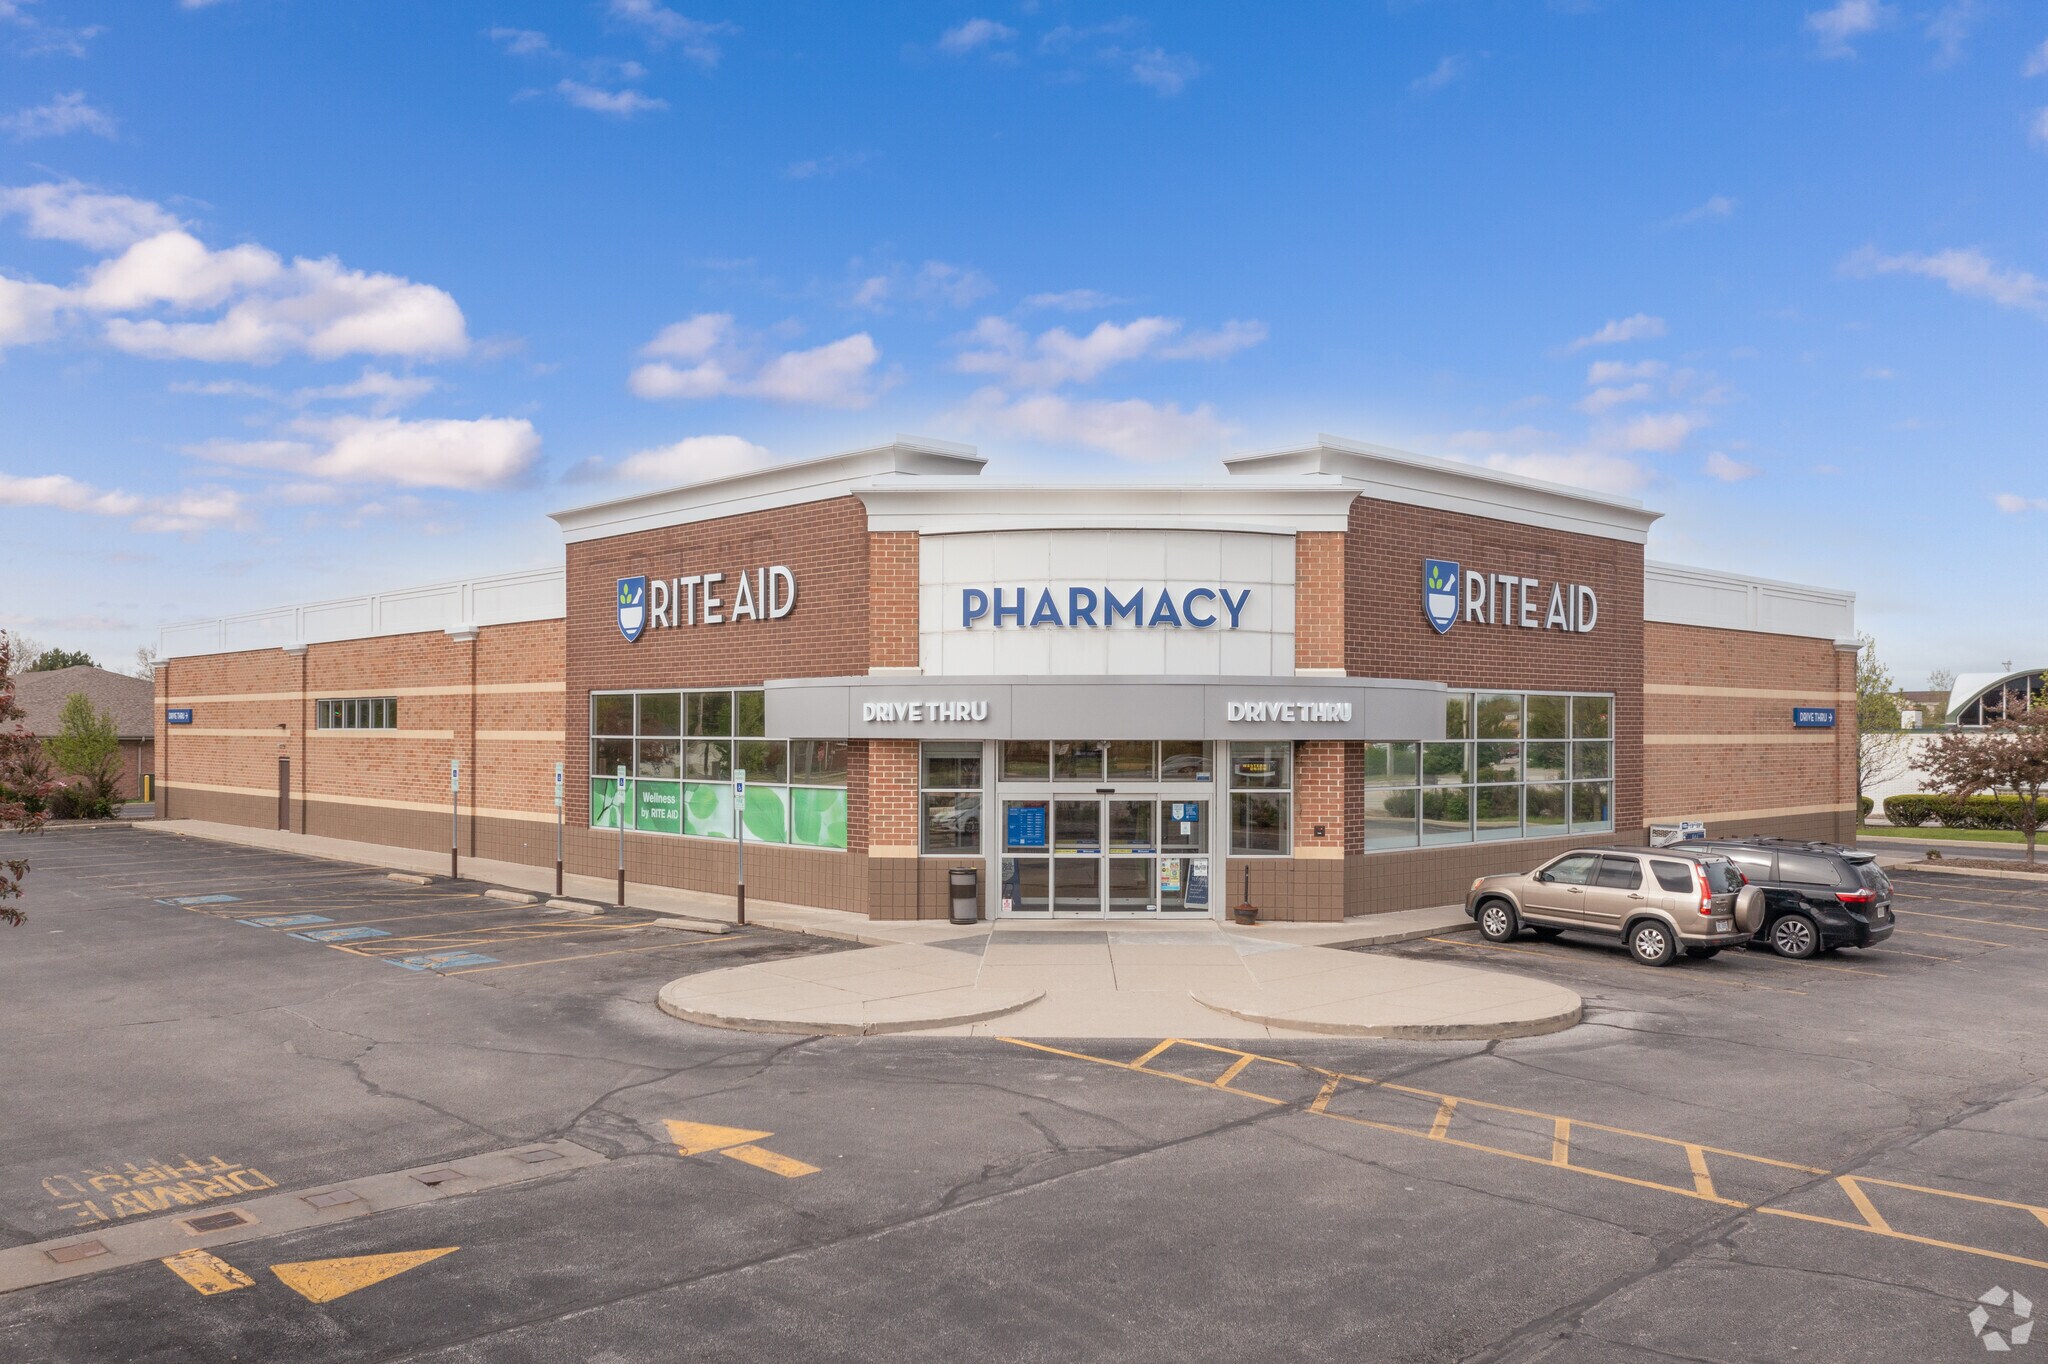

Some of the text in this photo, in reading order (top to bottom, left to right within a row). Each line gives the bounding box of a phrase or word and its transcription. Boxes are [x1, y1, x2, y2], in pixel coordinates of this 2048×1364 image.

[651, 565, 798, 629] RITE AID
[961, 586, 1252, 629] PHARMACY
[1464, 570, 1598, 633] RITE AID
[863, 700, 988, 722] DRIVE THRU
[1227, 701, 1353, 722] DRIVE THRU
[1799, 712, 1828, 722] DRIVE THRU
[642, 791, 676, 805] Wellness
[640, 807, 679, 820] by RITE AID
